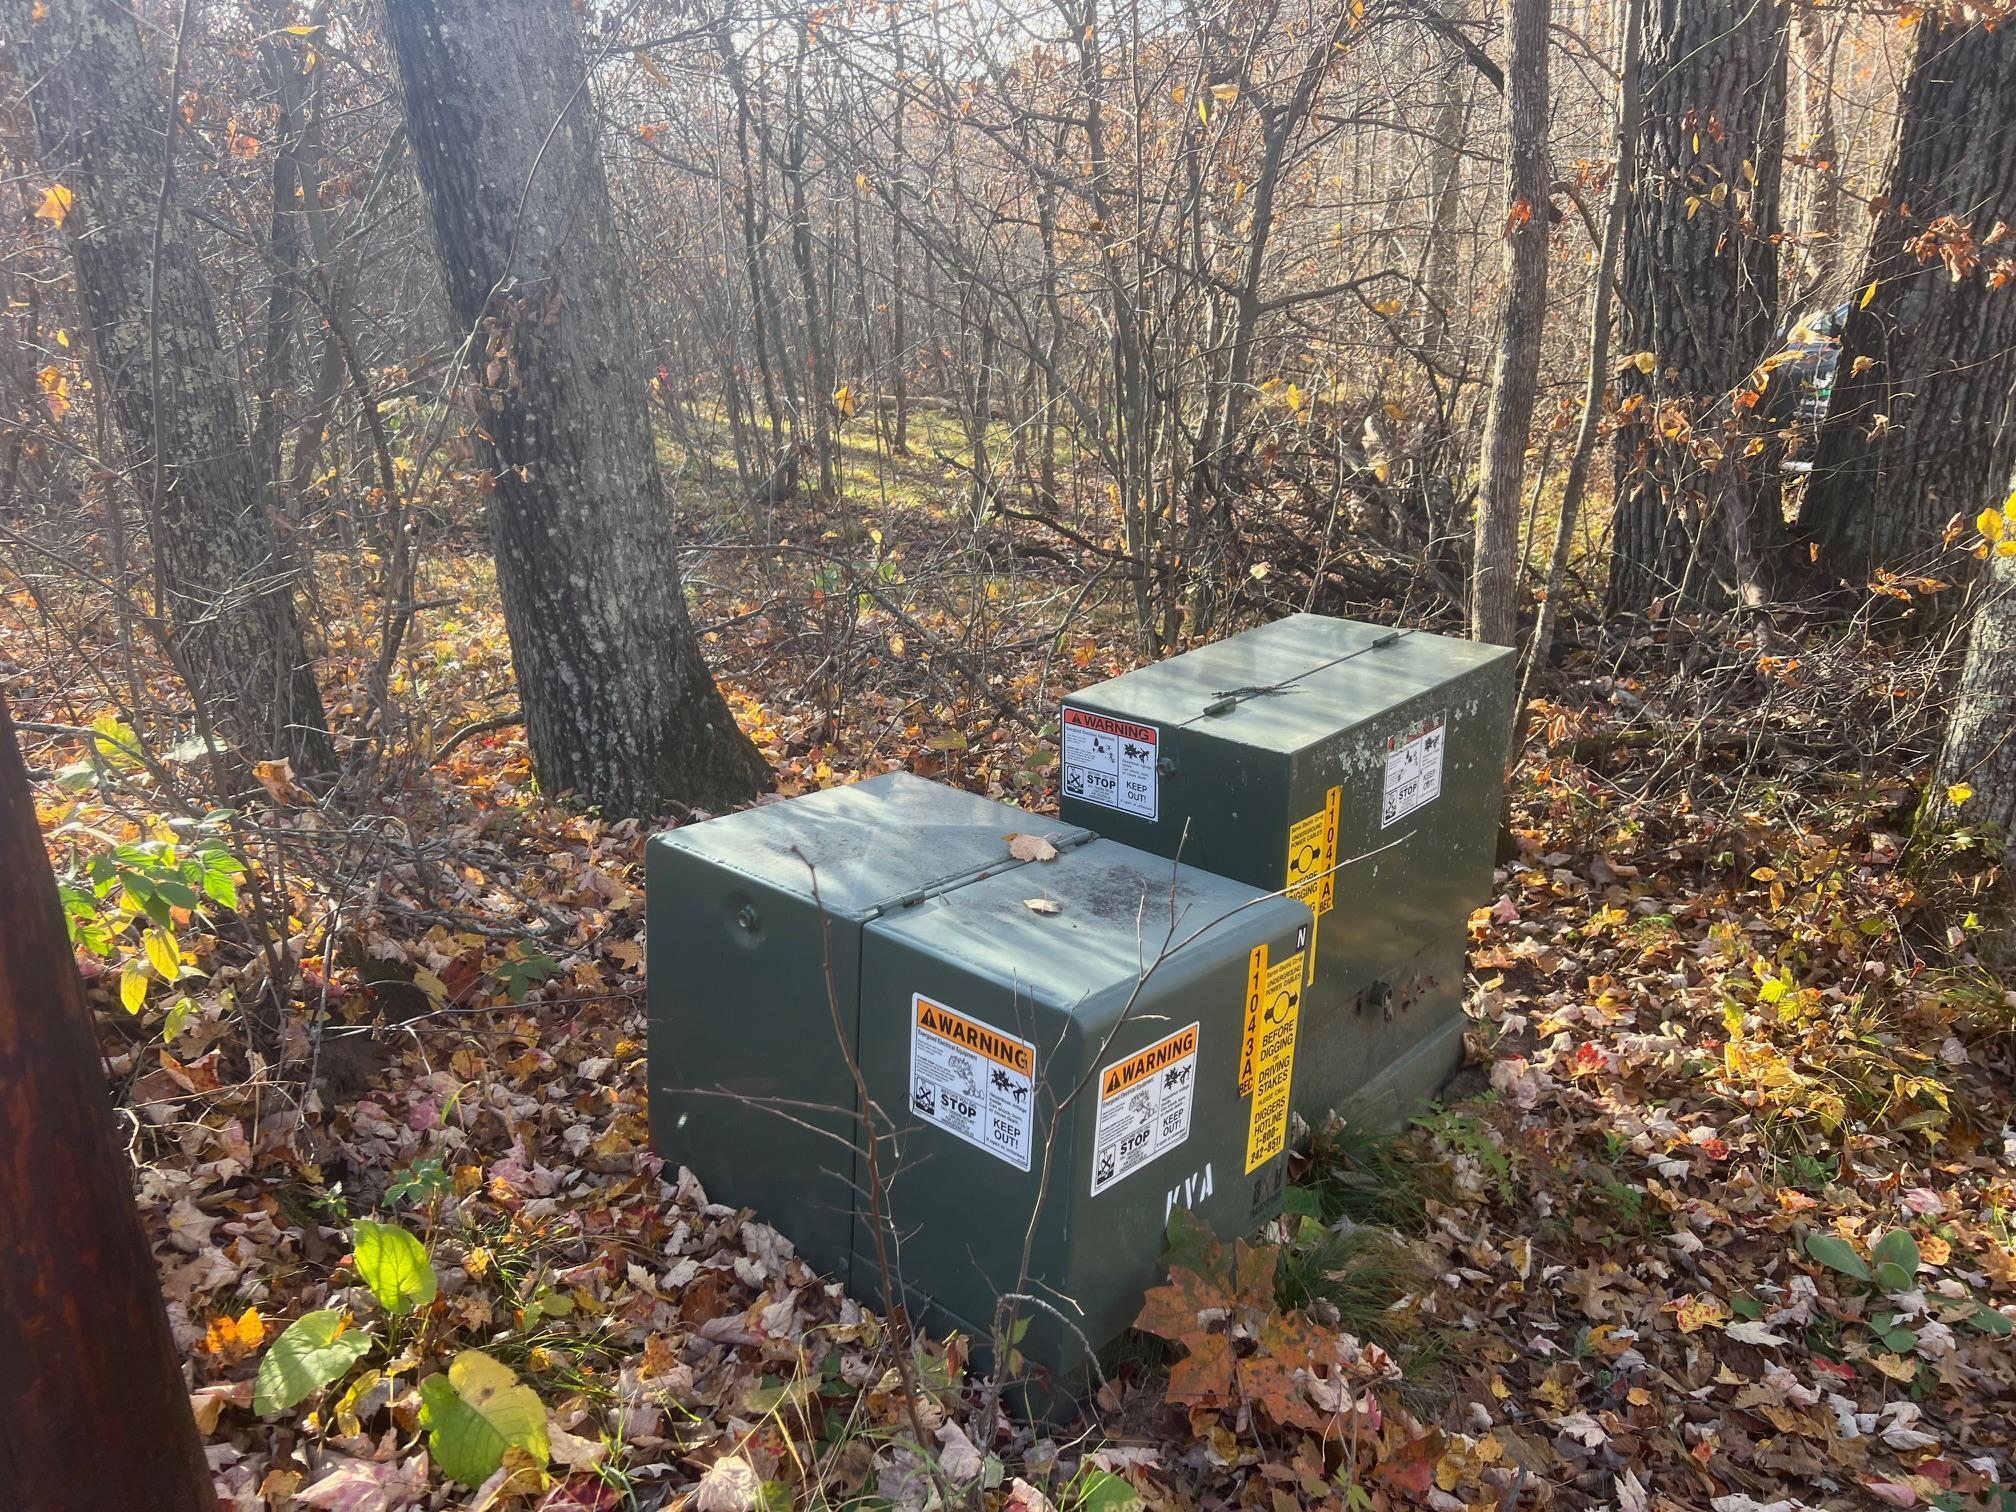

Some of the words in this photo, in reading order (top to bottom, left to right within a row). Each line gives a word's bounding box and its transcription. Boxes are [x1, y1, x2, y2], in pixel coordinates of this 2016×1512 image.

[1083, 715, 1148, 740] WARNING
[1087, 774, 1115, 789] STOP
[1126, 780, 1147, 793] KEEP
[1398, 782, 1417, 800] STOP
[1127, 791, 1146, 803] OUT!
[1290, 837, 1305, 848] POWER
[1306, 829, 1322, 840] CABLES
[1291, 821, 1322, 841] UNDERGROUND
[1319, 898, 1331, 913] BEC
[1297, 927, 1307, 948] N
[1265, 982, 1282, 996] POWER
[1283, 972, 1301, 986] CABLES
[1266, 964, 1301, 987] UNDERGROUND
[1242, 948, 1262, 1080] 11043A
[938, 1013, 1028, 1070] WARNING
[1262, 1019, 1294, 1047] BEFORE
[1121, 1032, 1193, 1084] WARNING
[1260, 1032, 1293, 1061] DIGGING
[1258, 1054, 1290, 1083] DRIVING
[1239, 1076, 1253, 1095] BEC
[1257, 1068, 1288, 1097] STAKES
[940, 1093, 976, 1120] STOP
[988, 1101, 997, 1109] Can
[1257, 1092, 1273, 1106] PLEASE
[1274, 1084, 1285, 1096] CALL
[1162, 1107, 1183, 1127] KEEP
[1254, 1095, 1285, 1124] DIGGERS
[993, 1117, 1020, 1139] KEEP
[1162, 1118, 1181, 1137] OUT!
[1253, 1109, 1283, 1136] HOTLINE
[994, 1128, 1018, 1149] OUT!
[1120, 1129, 1150, 1155] STOP
[1255, 1123, 1279, 1148] 1-800-
[1250, 1133, 1281, 1164] 242-8511
